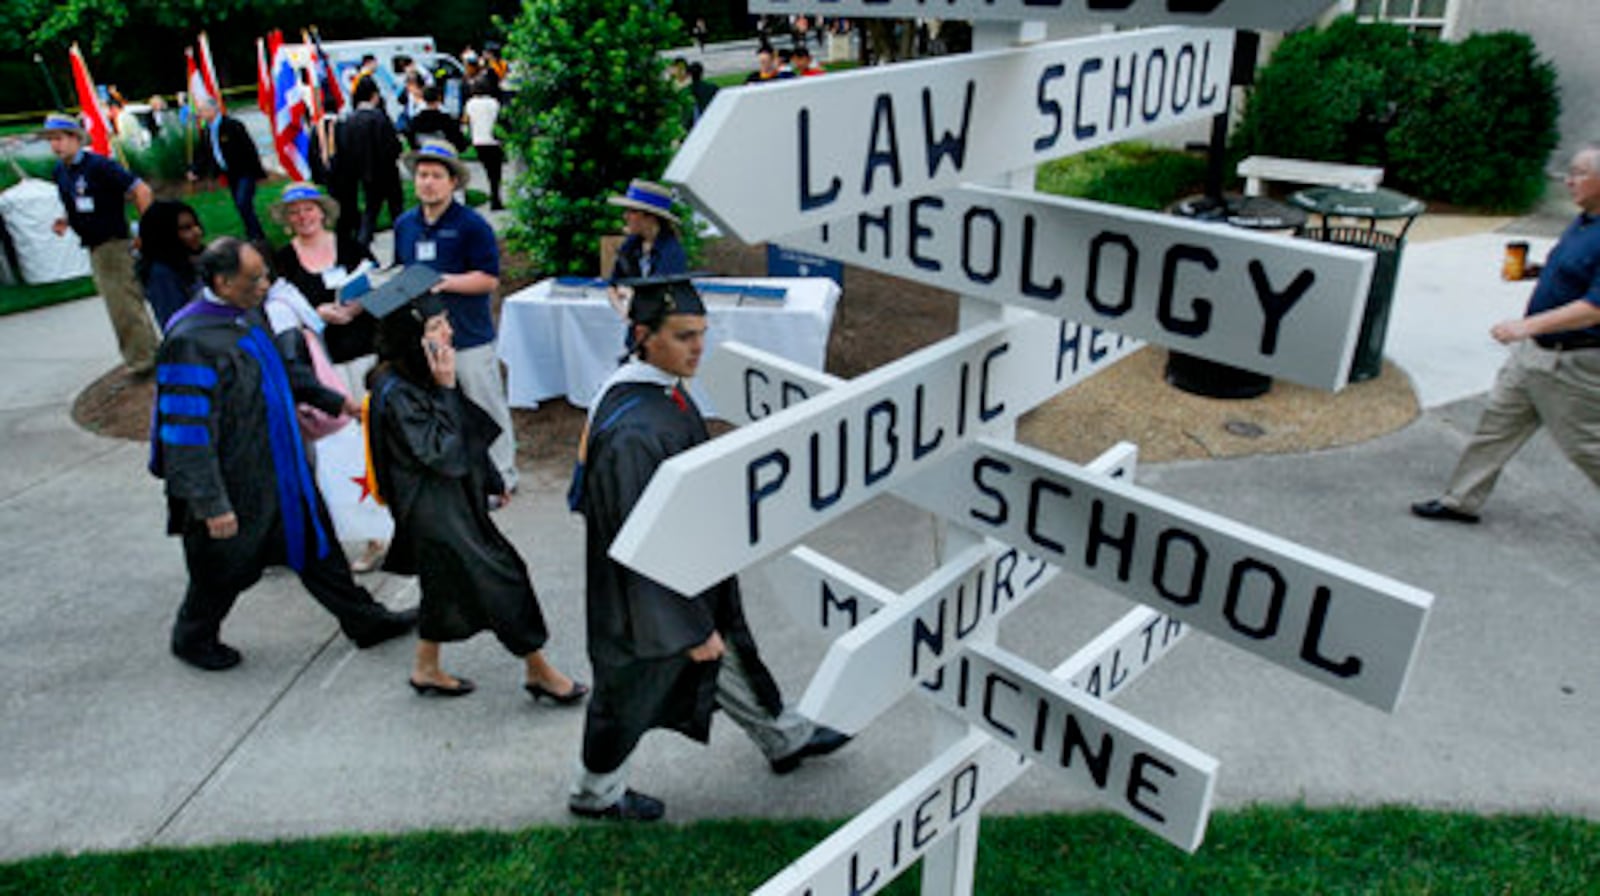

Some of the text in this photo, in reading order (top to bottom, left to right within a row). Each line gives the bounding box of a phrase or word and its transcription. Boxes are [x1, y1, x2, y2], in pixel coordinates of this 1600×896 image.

[798, 40, 1217, 212] LAW SCHOOL
[746, 342, 1010, 546] PUBLIC
[969, 455, 1364, 680] SCHOOL
[803, 762, 978, 896] LIED
